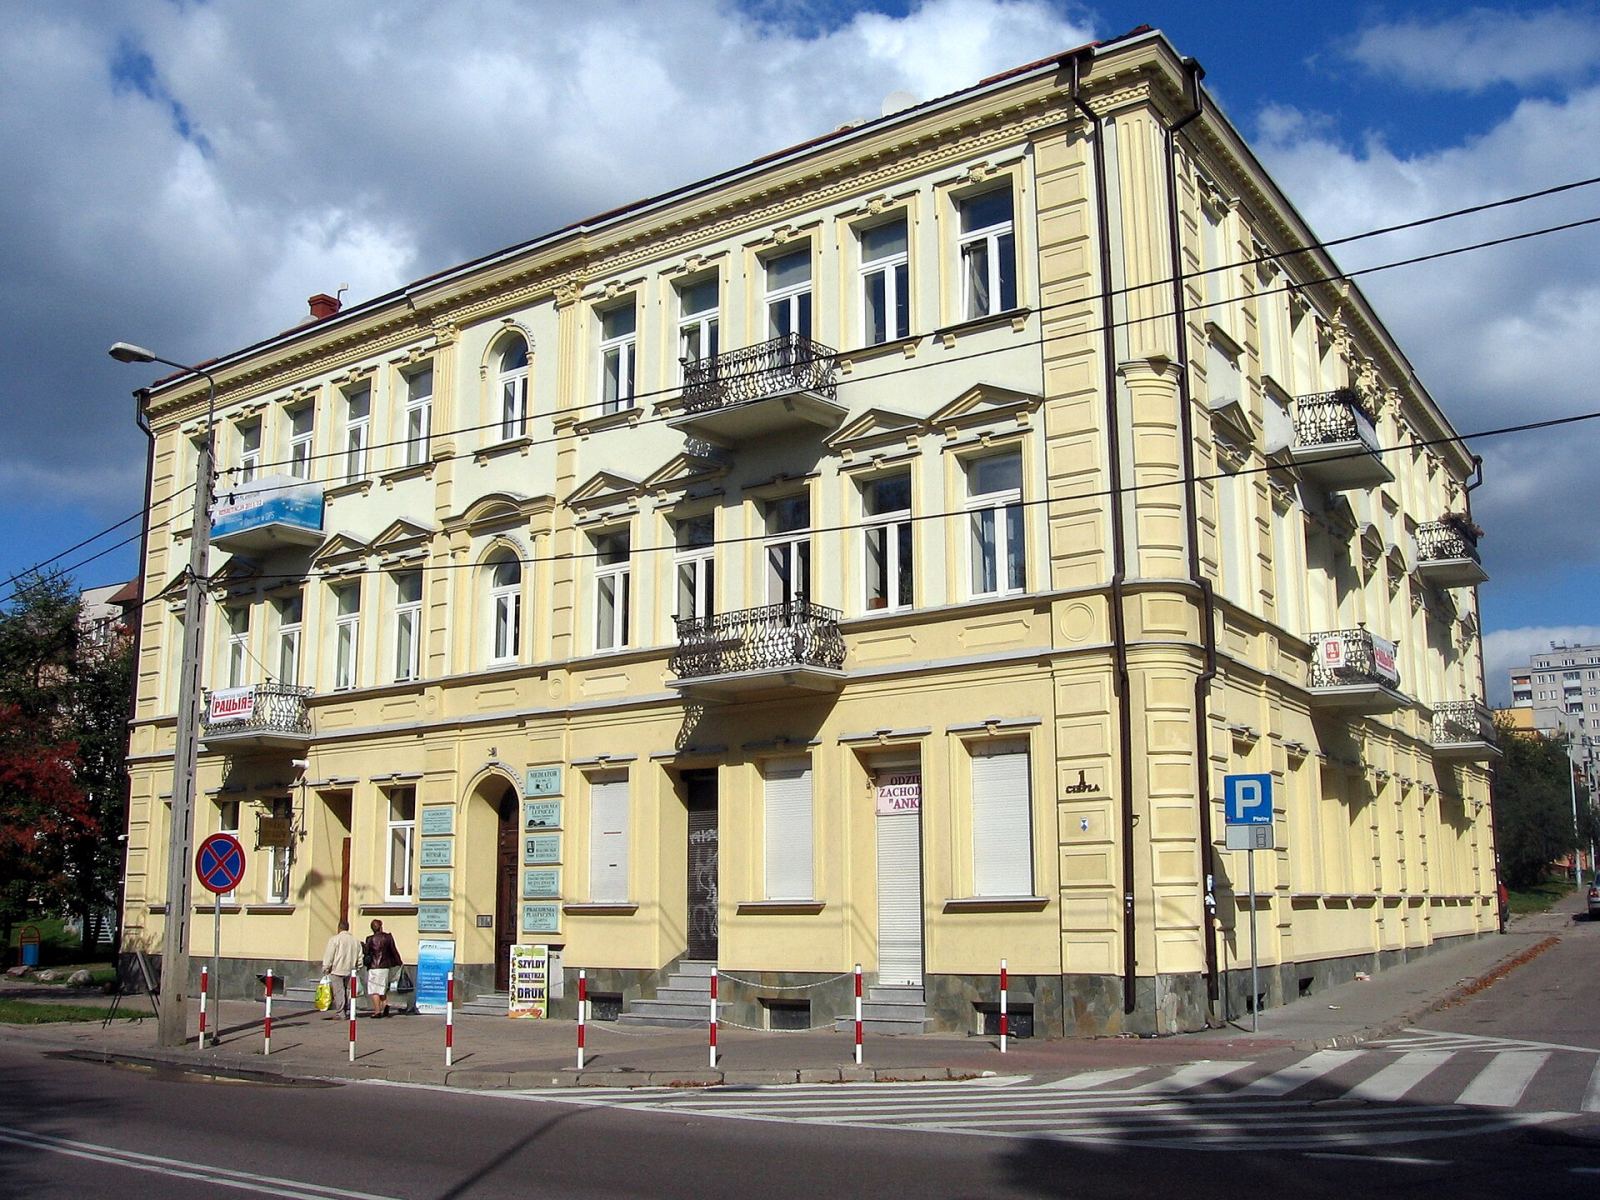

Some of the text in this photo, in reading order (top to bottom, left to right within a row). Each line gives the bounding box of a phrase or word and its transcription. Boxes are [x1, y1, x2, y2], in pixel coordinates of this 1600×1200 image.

[214, 697, 247, 713] РАЦЫЯ
[1078, 770, 1086, 785] 1
[1235, 780, 1262, 818] P
[517, 960, 545, 969] SZYLDY
[517, 987, 545, 999] DRUK
